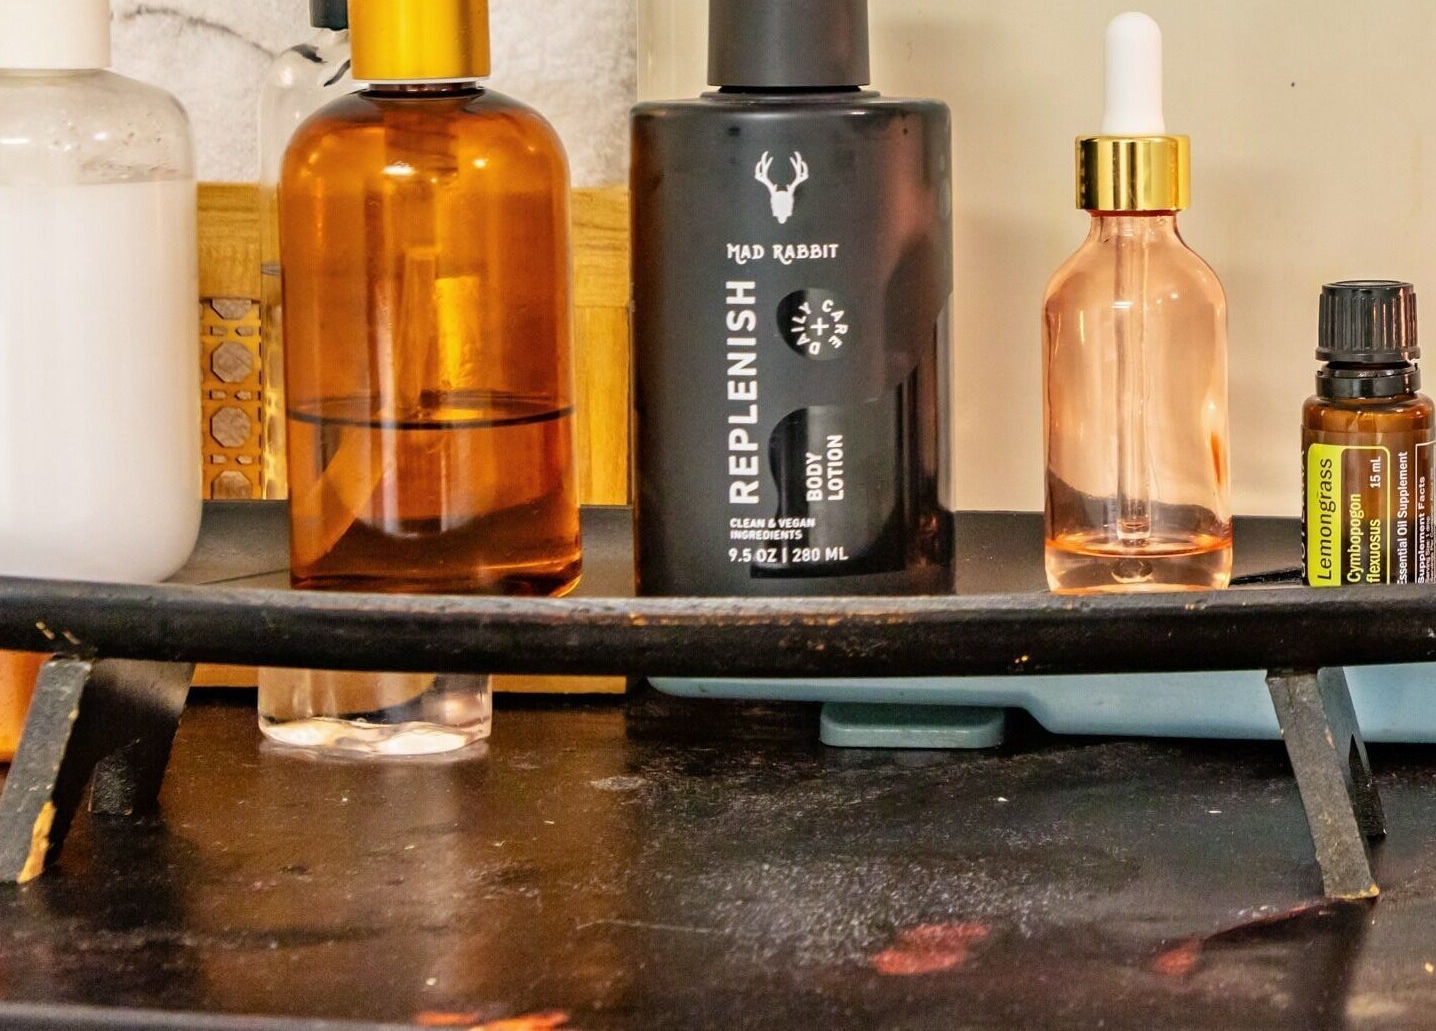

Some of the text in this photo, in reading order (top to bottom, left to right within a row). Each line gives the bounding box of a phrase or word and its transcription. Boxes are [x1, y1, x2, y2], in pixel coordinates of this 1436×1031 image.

[726, 243, 839, 265] MAD RABBIT
[791, 299, 849, 355] DAILY CARE
[725, 281, 759, 504] REPLENISH
[805, 452, 823, 502] BODY
[826, 434, 844, 501] LOTION
[1370, 456, 1381, 488] 15 mL
[1397, 451, 1409, 518] Supplement
[729, 518, 816, 529] CLEAN & VEGAN
[730, 530, 803, 540] INGREDIENTS
[1317, 458, 1336, 581] Lemongrass
[1347, 493, 1364, 583] Cymbopogon
[1397, 520, 1408, 536] Oil
[1418, 476, 1426, 584] Supplement Facts
[728, 547, 752, 563] 9.5
[756, 548, 777, 563] OZ
[792, 547, 821, 563] 280
[825, 546, 849, 561] ML
[1366, 519, 1381, 584] flexuosus
